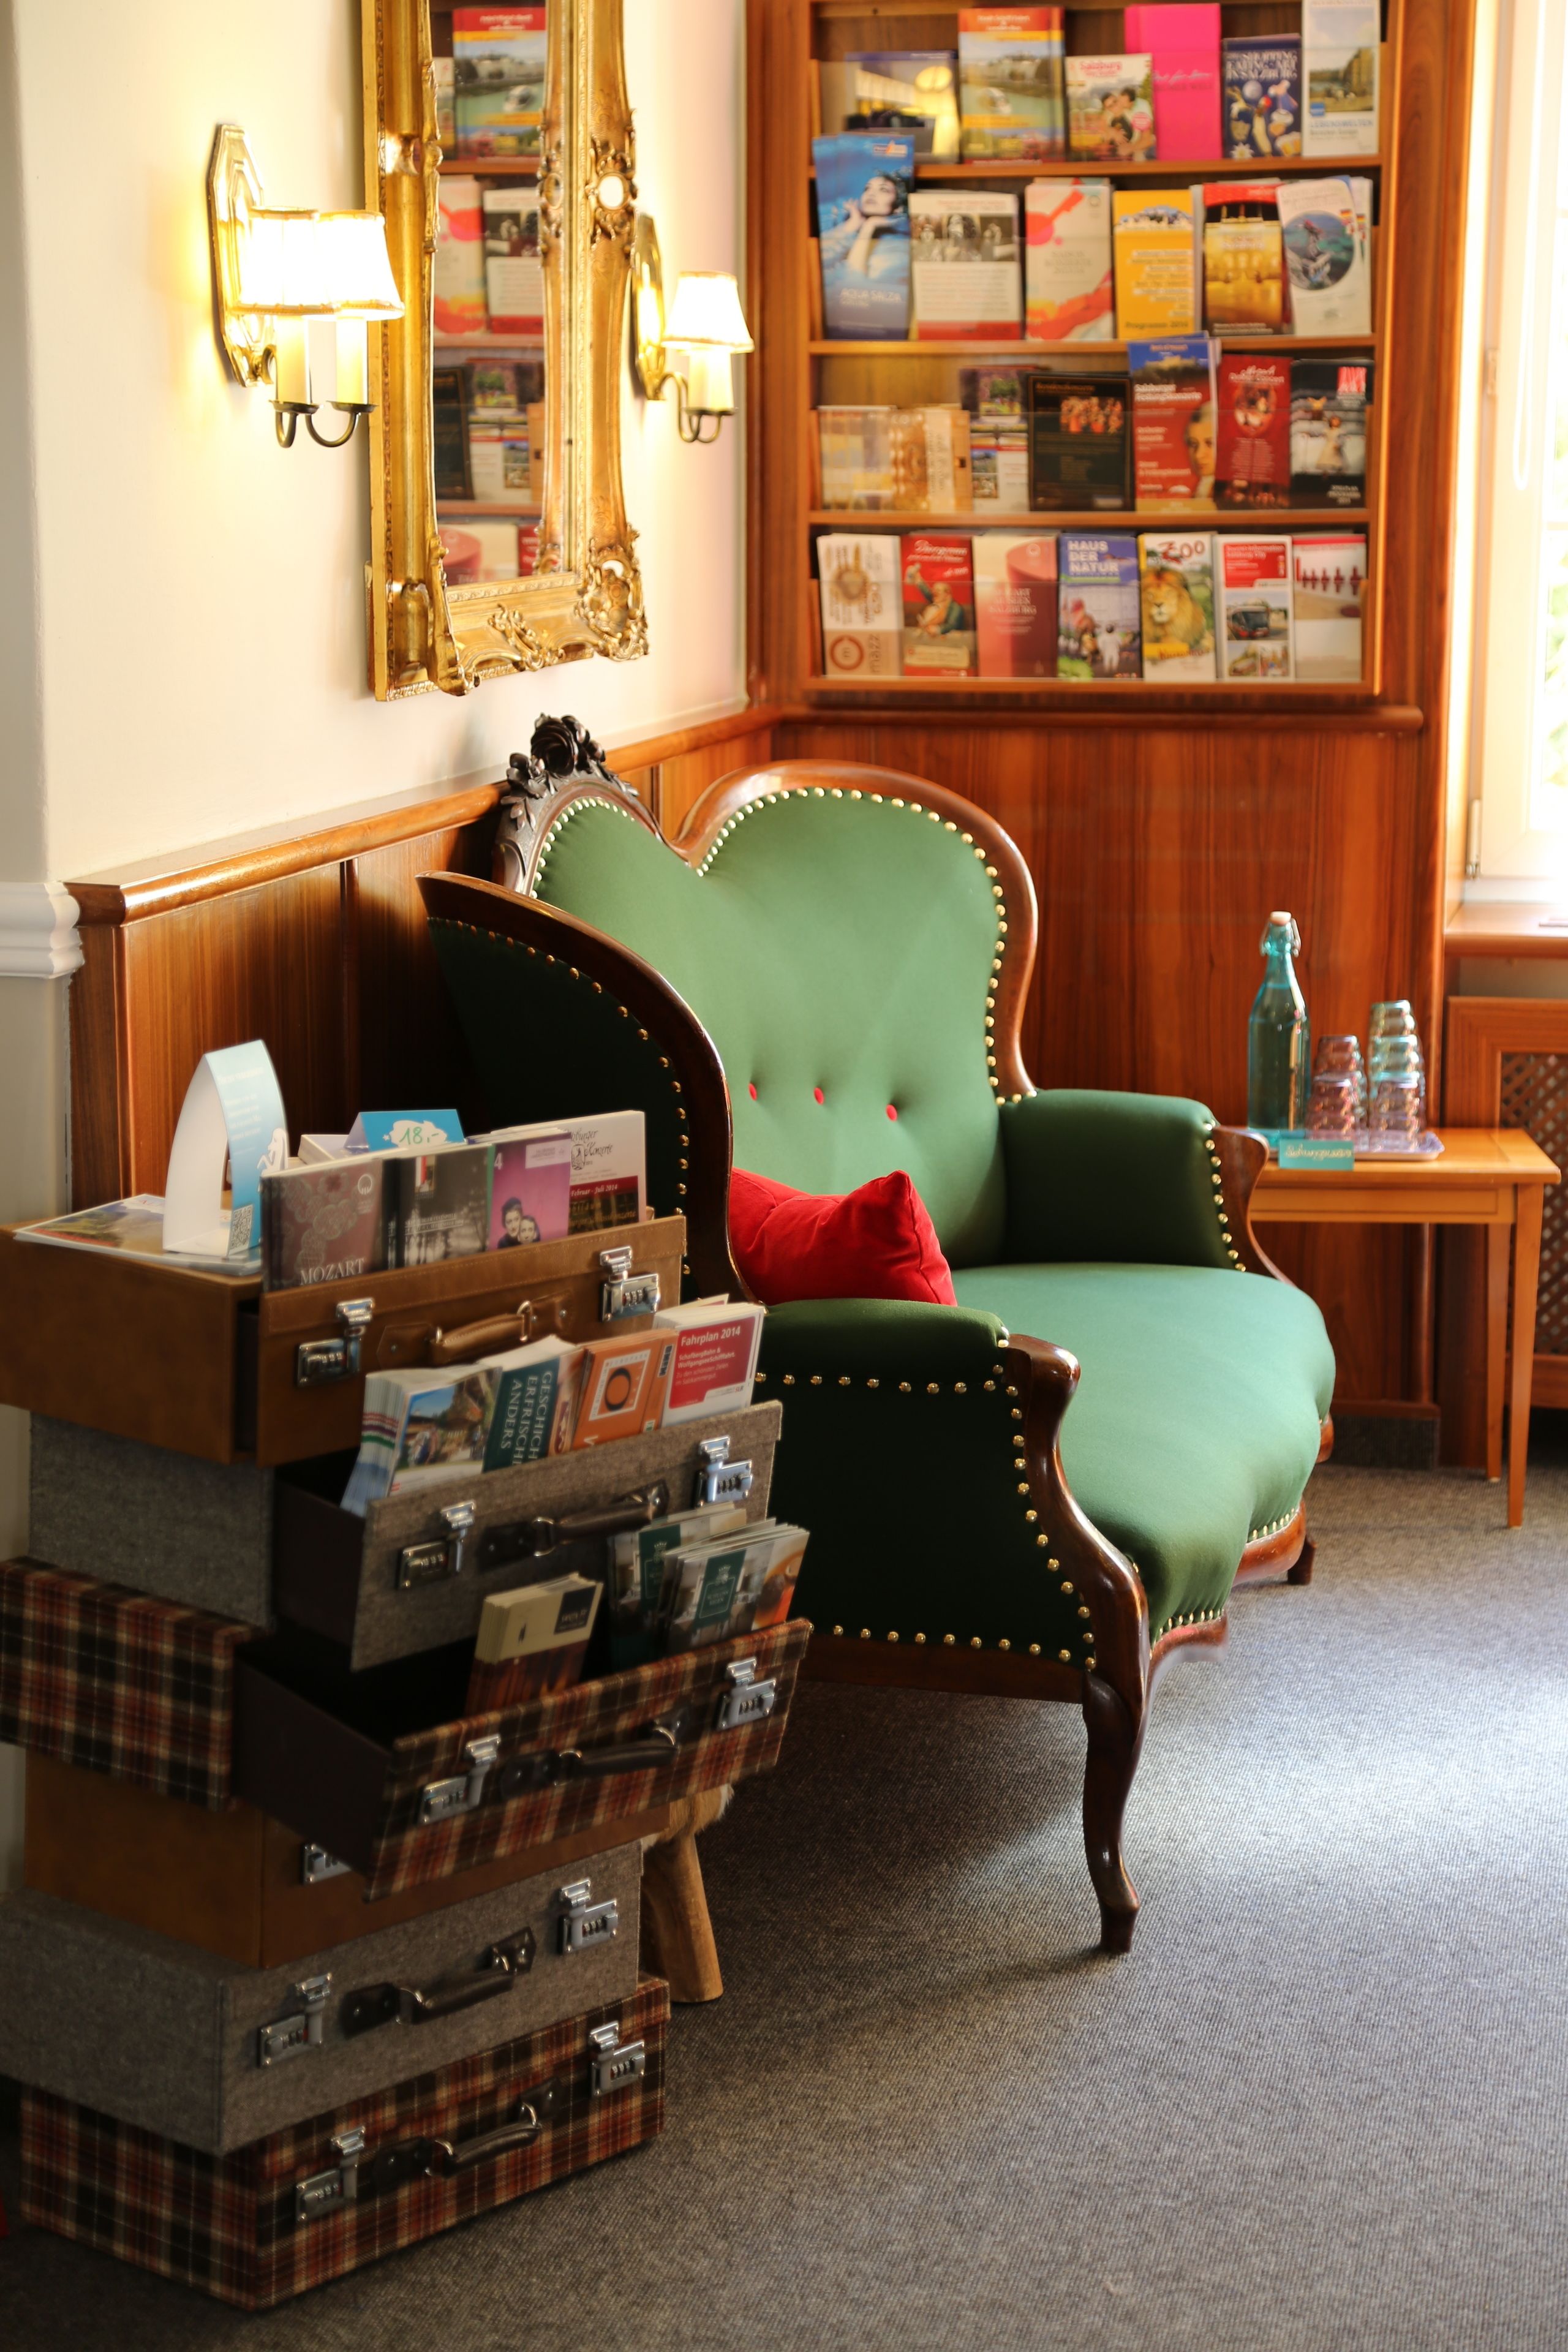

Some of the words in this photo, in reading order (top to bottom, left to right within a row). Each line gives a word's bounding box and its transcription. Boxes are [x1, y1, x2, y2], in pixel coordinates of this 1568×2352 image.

[1067, 540, 1109, 551] HAUS
[1068, 551, 1098, 562] DER
[1069, 562, 1119, 573] NATUR
[300, 1257, 365, 1286] MOZART
[681, 1332, 718, 1347] Fahrplan
[720, 1326, 741, 1340] 2014
[501, 1379, 522, 1449] ANDERS
